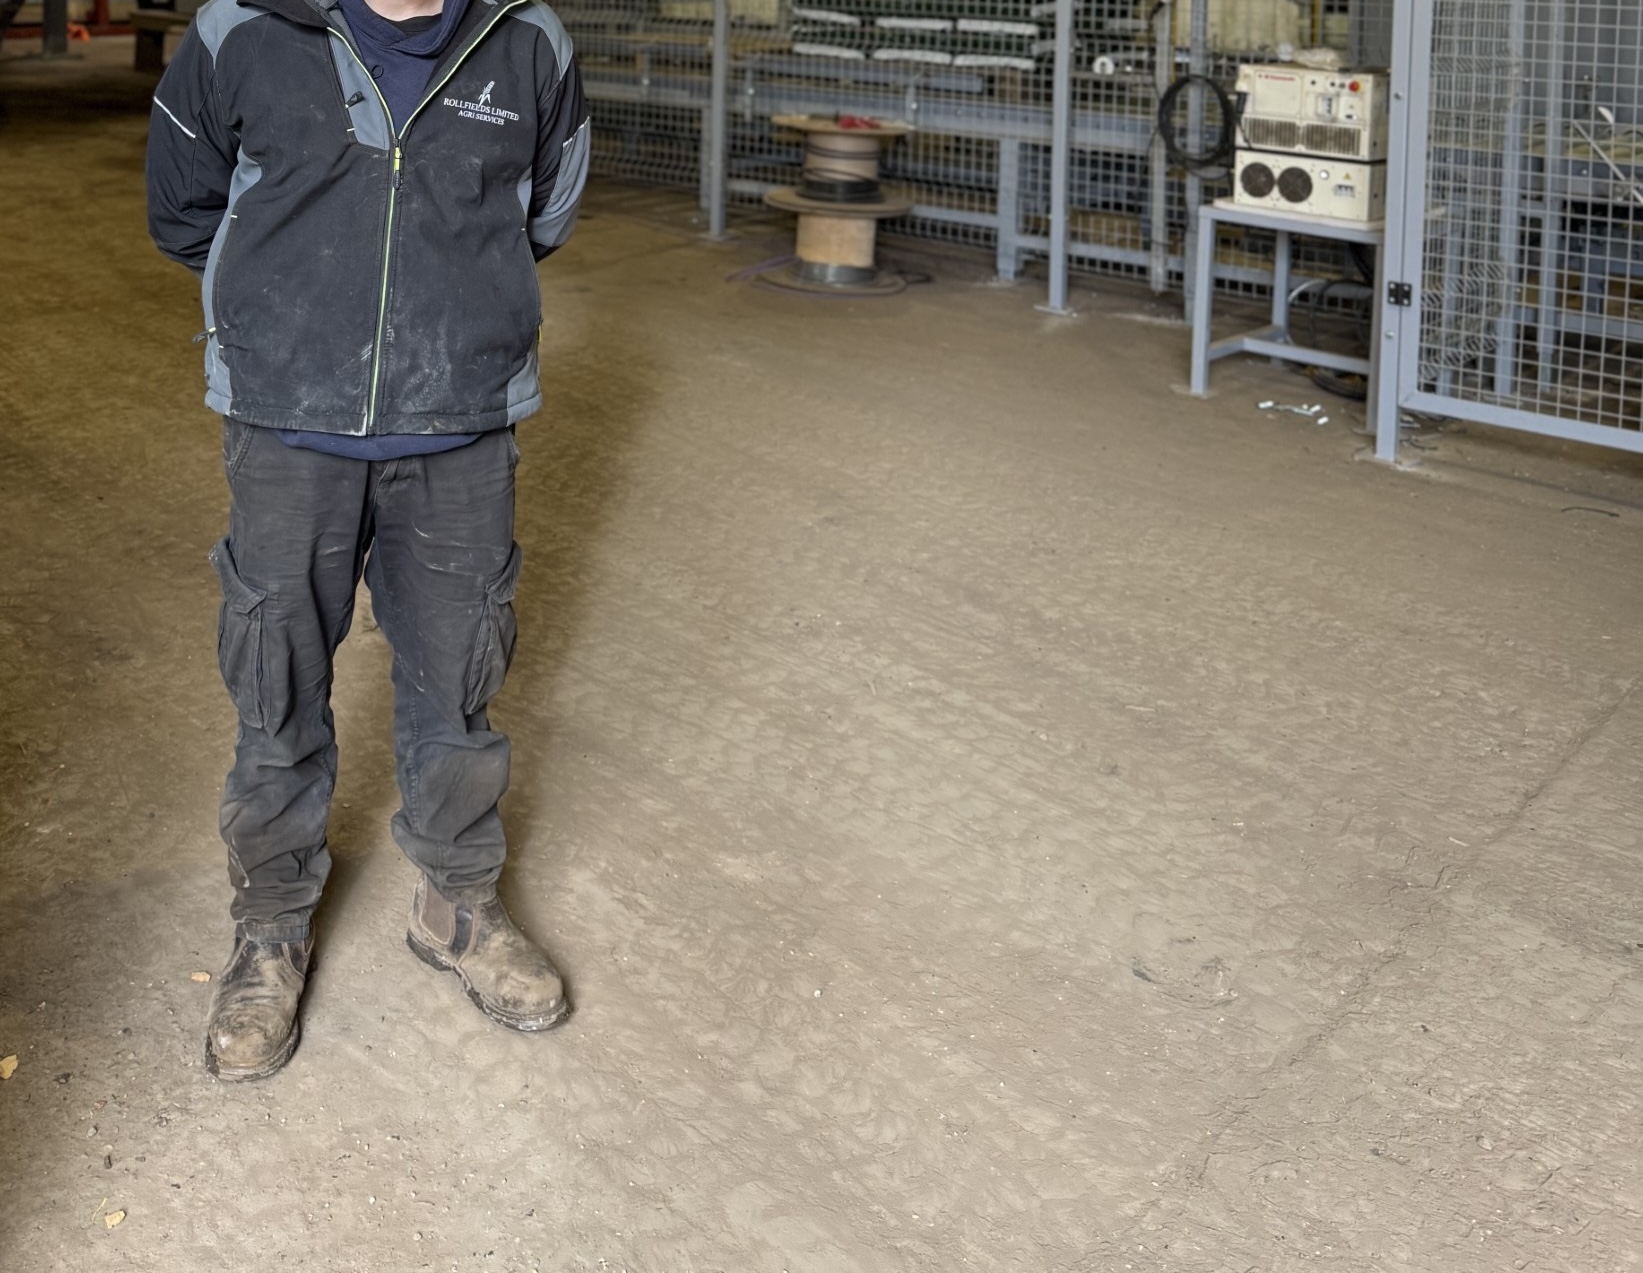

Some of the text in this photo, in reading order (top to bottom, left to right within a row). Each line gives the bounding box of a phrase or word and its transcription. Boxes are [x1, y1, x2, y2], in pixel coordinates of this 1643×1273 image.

[444, 98, 519, 121] ROLLFIELDS LIMITED
[458, 110, 505, 125] AGRI SERVICES
